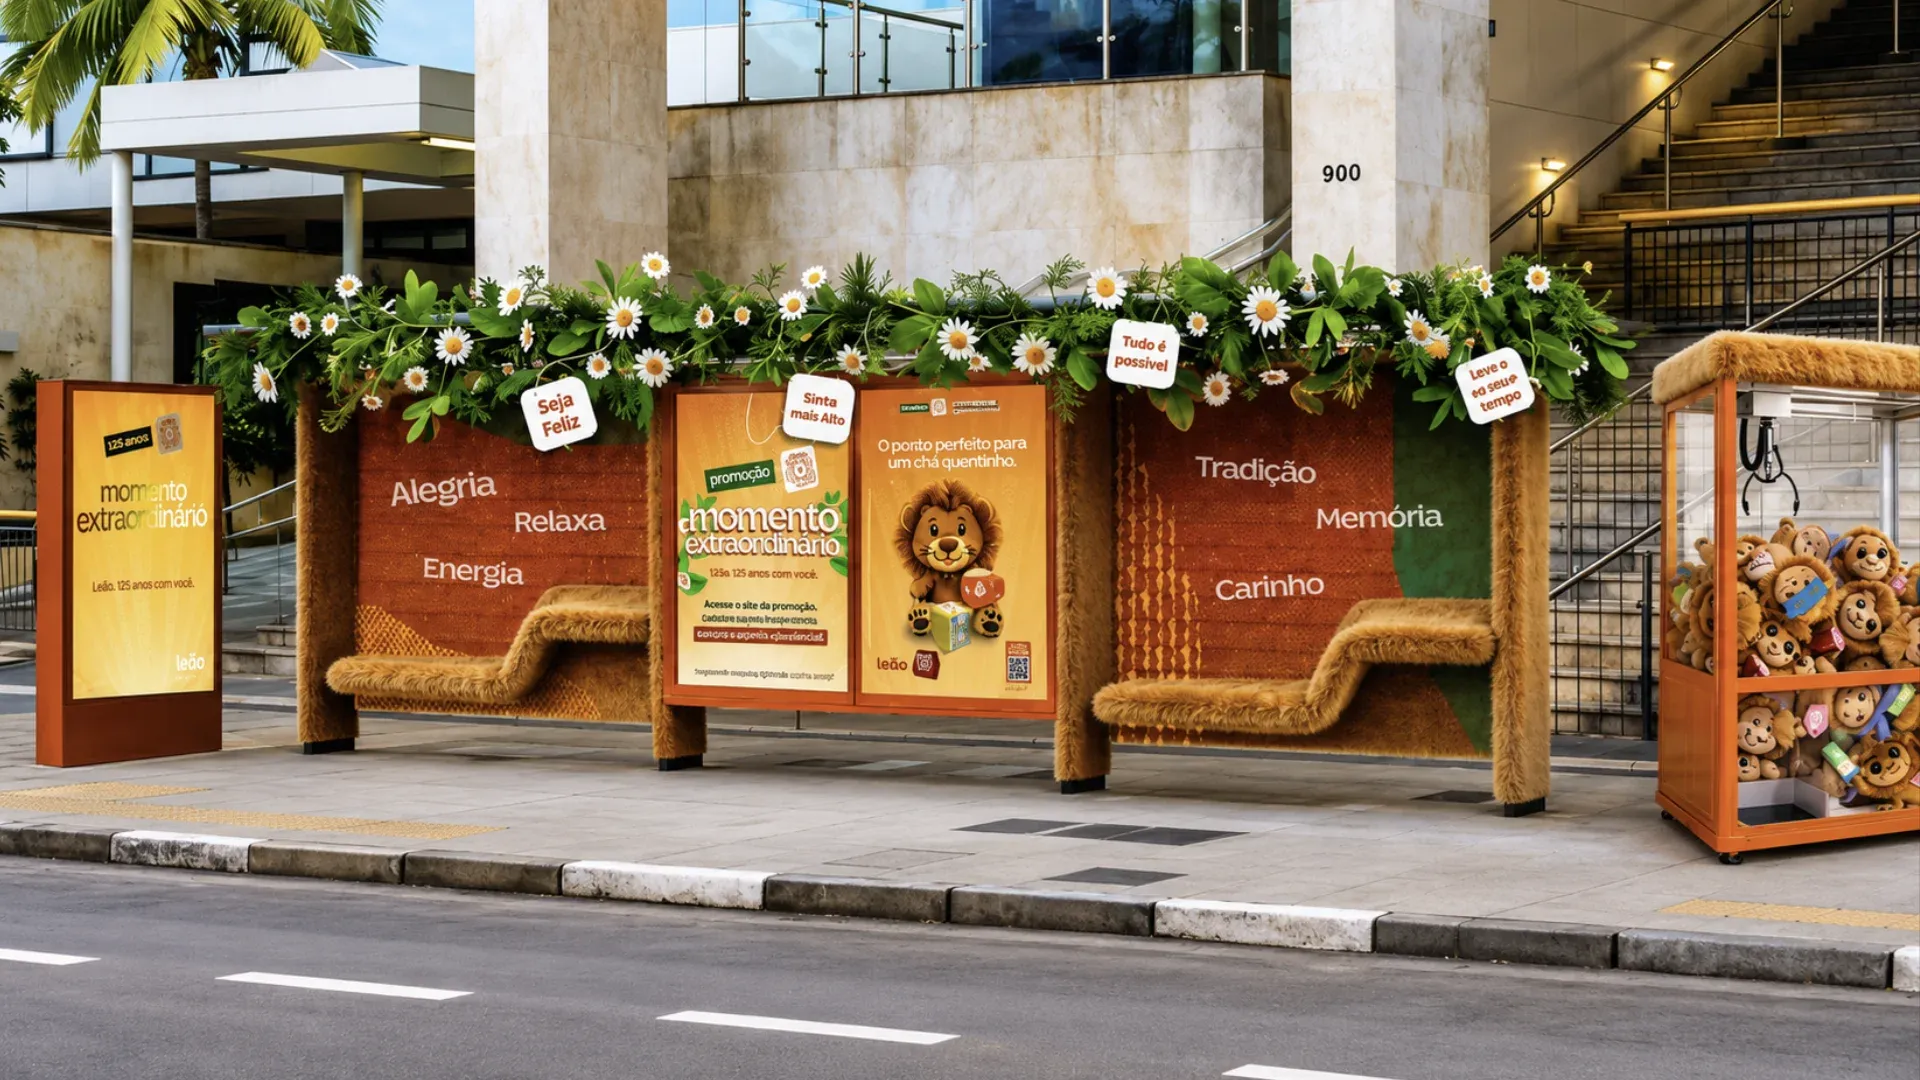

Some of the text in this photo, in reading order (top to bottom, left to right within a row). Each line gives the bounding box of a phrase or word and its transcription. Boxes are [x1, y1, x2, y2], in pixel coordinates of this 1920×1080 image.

[1323, 164, 1361, 183] 900
[1122, 335, 1166, 352] Tudo é
[1469, 360, 1508, 381] Leve o
[537, 393, 574, 415] Seja
[803, 392, 837, 407] Sinta
[1479, 390, 1522, 412] tempo
[542, 415, 581, 437] Feliz
[790, 409, 846, 426] mais Alto
[107, 433, 149, 451] 125 anos
[878, 439, 890, 452] O
[935, 437, 991, 455] perfeito
[994, 438, 1027, 453] para
[888, 453, 1017, 472] um chá quentinho.
[1194, 455, 1317, 488] Tradição
[710, 466, 770, 489] promoção
[101, 480, 187, 503] momento
[390, 471, 498, 507] Alegria
[514, 510, 606, 533] Relaxa
[1316, 504, 1444, 530] Memória
[423, 557, 525, 588] Energia
[748, 570, 770, 578] anos
[771, 571, 792, 579] com
[117, 580, 131, 591] 125
[132, 581, 153, 590] anos
[153, 580, 172, 588] com
[1215, 574, 1325, 601] Carinho
[704, 599, 734, 609] Acesse
[742, 601, 758, 609] site
[760, 601, 771, 610] da
